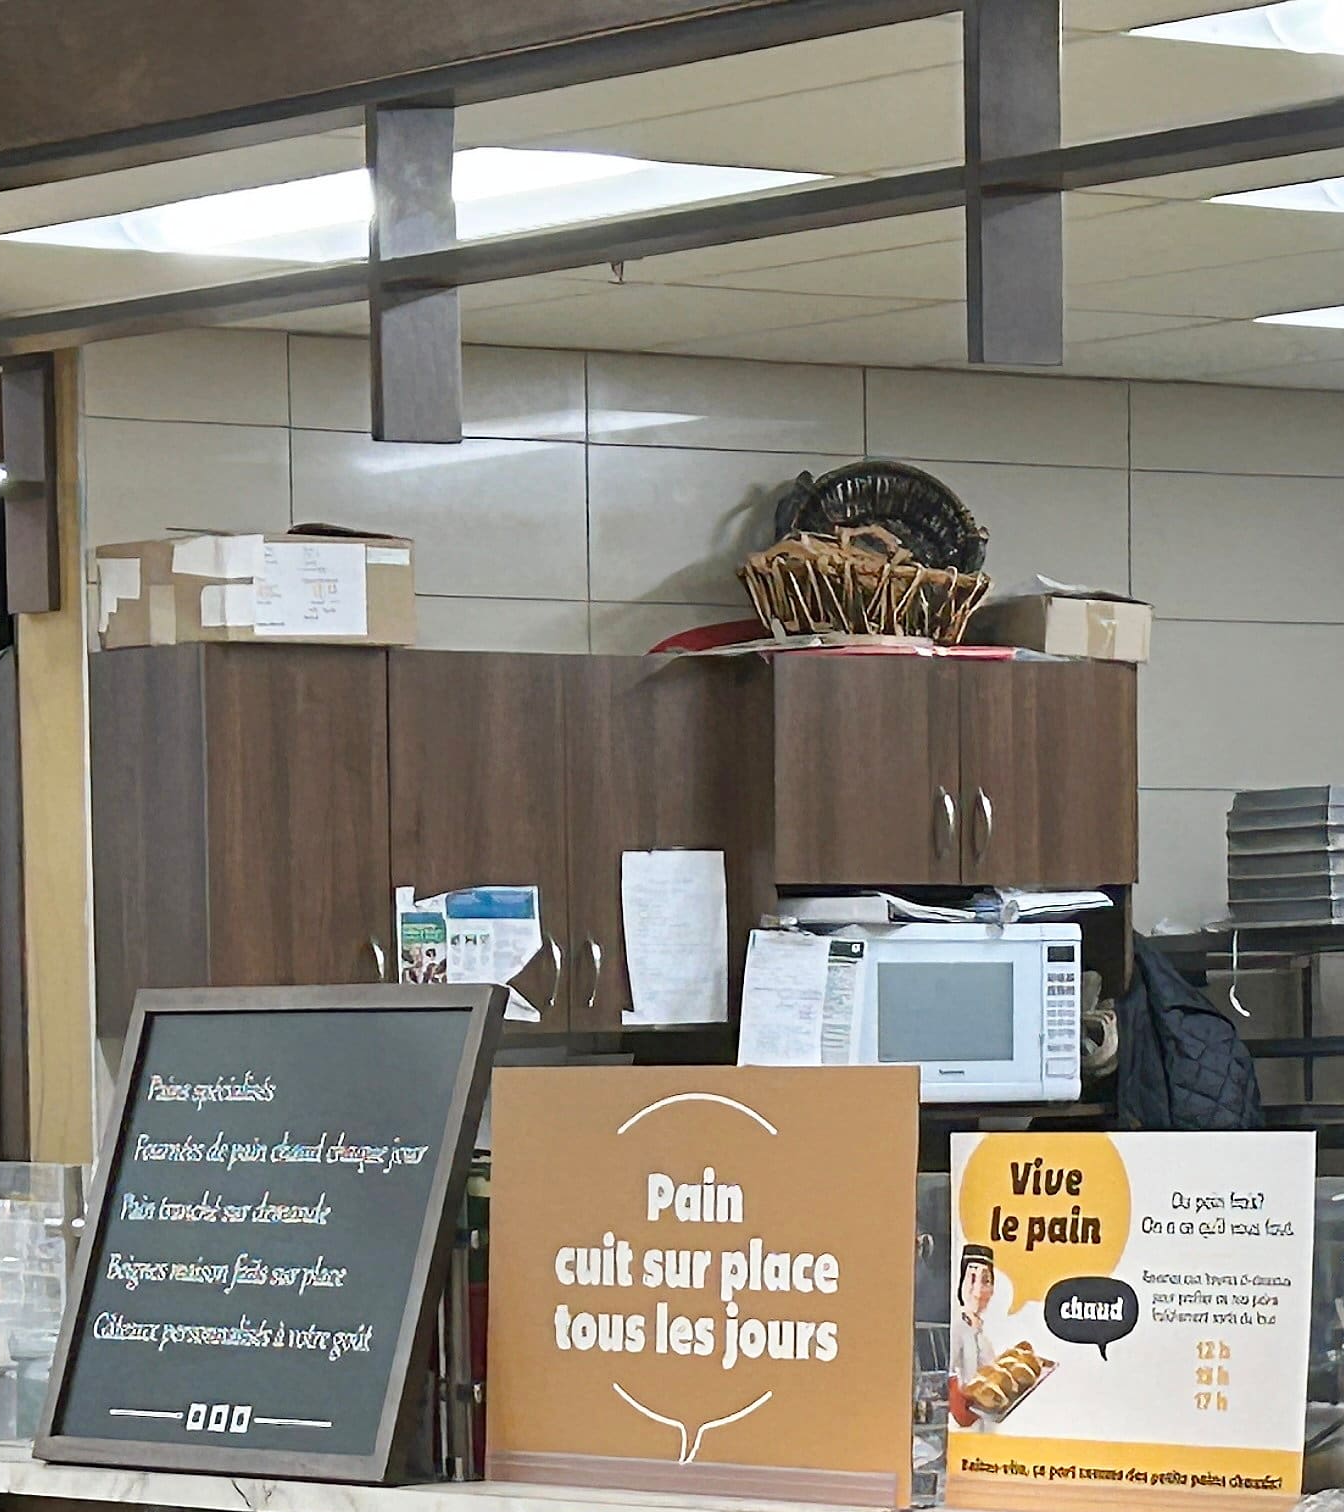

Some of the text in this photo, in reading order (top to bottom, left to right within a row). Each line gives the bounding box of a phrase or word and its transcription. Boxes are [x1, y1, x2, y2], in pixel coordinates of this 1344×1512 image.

[206, 1131, 226, 1163] de
[227, 1137, 268, 1171] pain
[383, 1136, 429, 1173] jour
[646, 1166, 744, 1224] Pain
[1010, 1157, 1083, 1196] Vive
[120, 1192, 156, 1222] Pain
[221, 1202, 252, 1223] sur
[990, 1205, 1102, 1251] le pain
[270, 1265, 301, 1287] sur
[555, 1231, 840, 1302] cuit sur place
[1060, 1295, 1124, 1322] chaud
[554, 1301, 839, 1370] tous les jours
